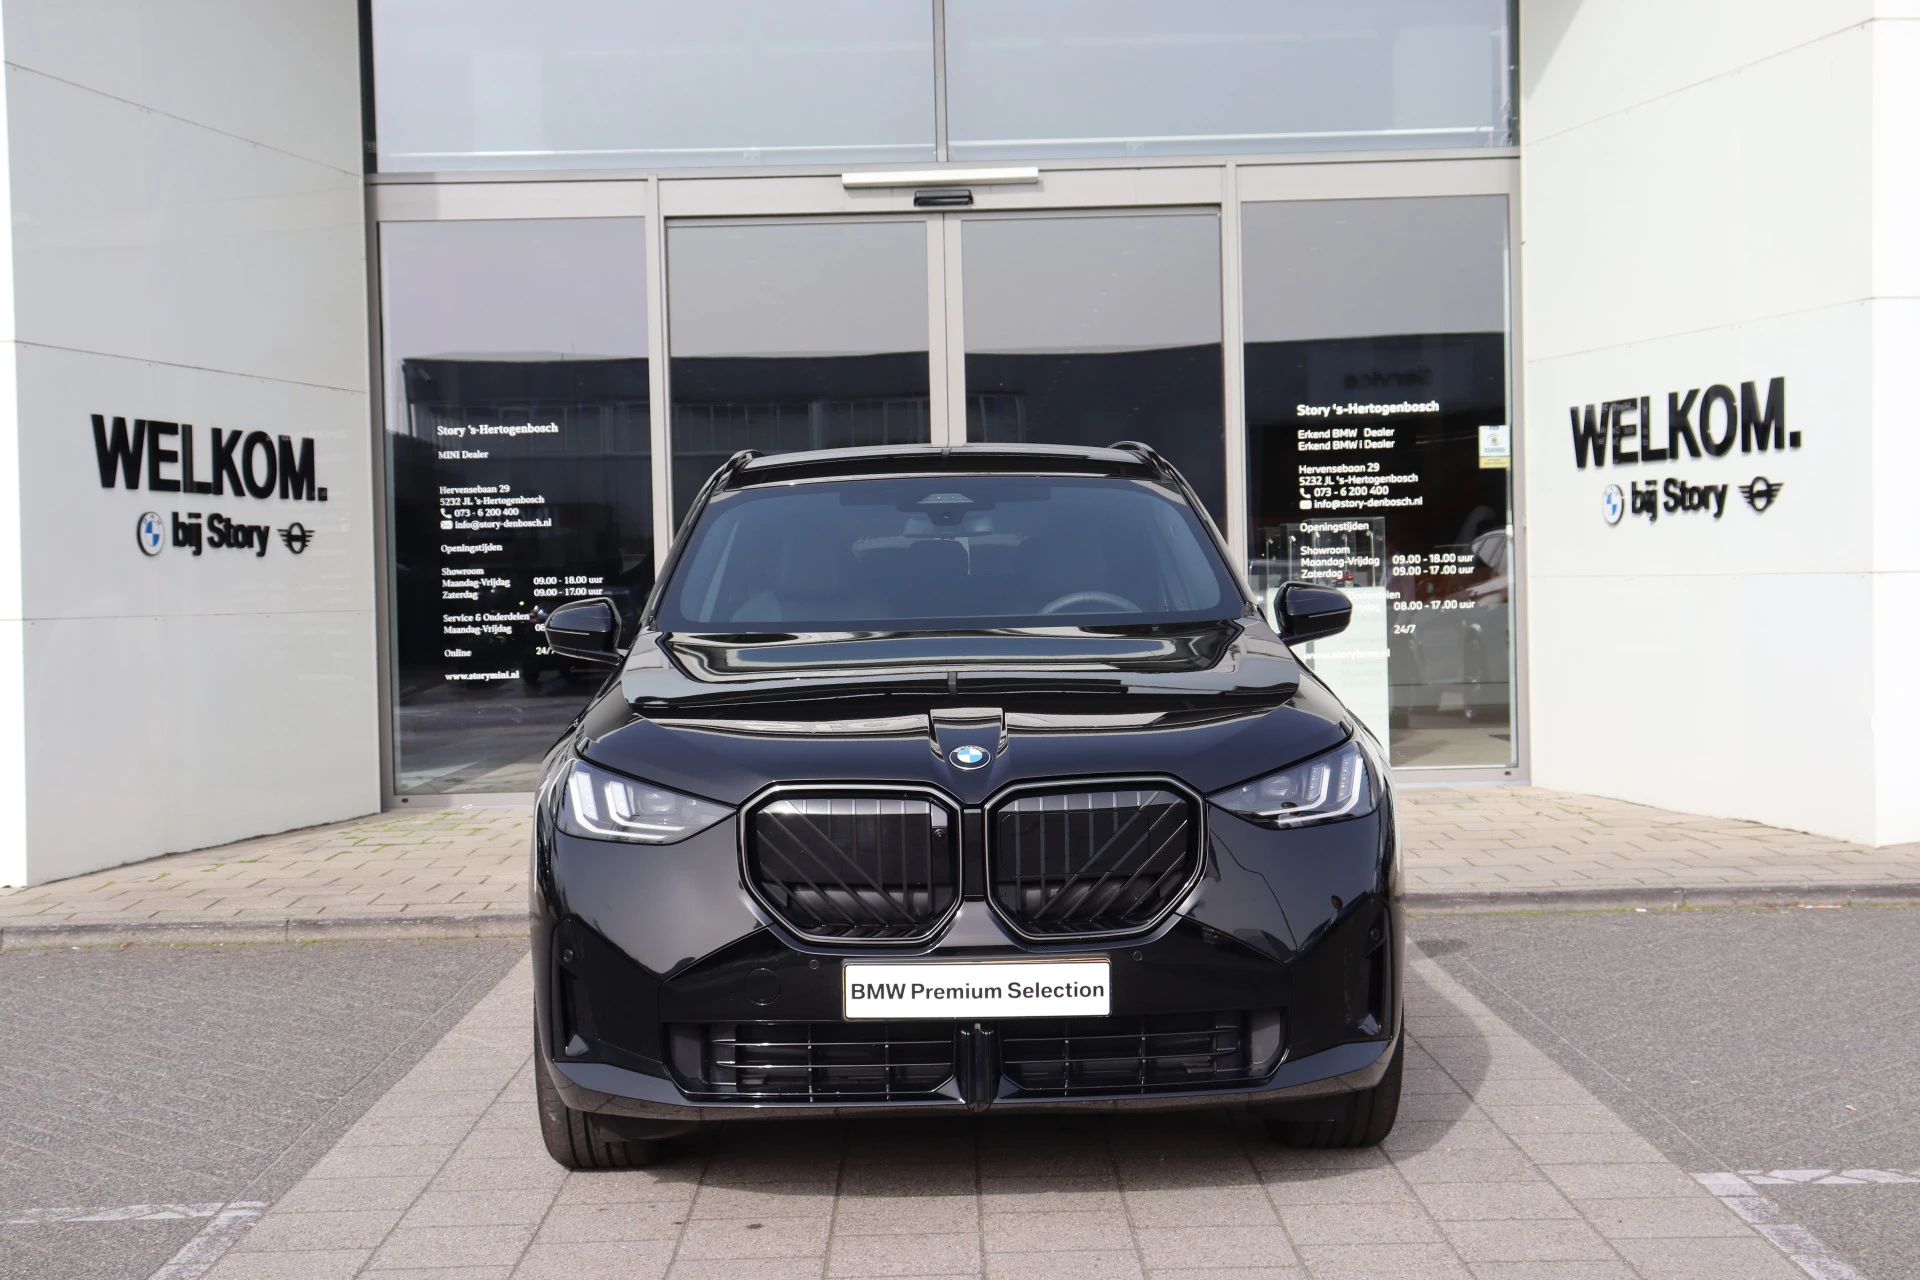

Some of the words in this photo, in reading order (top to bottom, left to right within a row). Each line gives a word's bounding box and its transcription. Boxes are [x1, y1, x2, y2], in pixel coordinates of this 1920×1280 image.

[1297, 404, 1330, 417] Story
[1332, 400, 1439, 415] 's-Hertogenbosch
[1570, 376, 1801, 469] WELKOM.
[437, 426, 466, 437] Story
[468, 423, 558, 436] 's-Hertogenbosch
[1298, 429, 1330, 439] Erkend
[1332, 429, 1357, 438] BMW
[1364, 428, 1395, 437] Dealer
[1298, 441, 1330, 451] Erkend
[1333, 440, 1358, 450] BMW
[1359, 440, 1363, 449] i
[1364, 439, 1395, 449] Dealer
[91, 414, 328, 501] WELKOM.
[438, 451, 460, 459] MINI
[462, 450, 489, 458] Dealer
[1299, 464, 1365, 474] Hervensebaan
[1367, 463, 1380, 472] 29
[1299, 476, 1322, 486] 5232
[1324, 476, 1335, 485] JL
[1336, 473, 1418, 485] 's-Hertogenbosch
[440, 485, 497, 494] Hervensebaan
[499, 485, 510, 493] 29
[1314, 488, 1331, 497] 073
[1340, 487, 1347, 496] 6
[1349, 486, 1367, 496] 200
[1369, 486, 1389, 495] 400
[440, 498, 461, 506] 5232
[462, 497, 473, 505] JL
[474, 495, 545, 506] 's-Hertogenbosch
[1314, 496, 1422, 510] info@story-denbosch.nl
[1632, 480, 1657, 521] bij
[1664, 478, 1727, 518] Story
[454, 509, 470, 517] 073
[485, 508, 501, 516] 200
[455, 518, 551, 530] info@story-denbosch.nl
[1300, 521, 1370, 534] Openingstijden
[172, 512, 202, 556] bij
[208, 513, 269, 557] Story
[441, 543, 503, 554] Openingstijden
[1299, 545, 1351, 556] Showroom
[1300, 556, 1380, 568] Maandag-Vrijdag
[1392, 555, 1421, 564] 09.00
[1429, 553, 1456, 563] 18.00
[1301, 570, 1344, 580] Zaterdag
[1392, 566, 1421, 576] 09.00
[1429, 565, 1456, 574] 17.00
[442, 578, 511, 588] Maandag-Vrijdag
[533, 577, 557, 585] 09.00
[565, 576, 587, 584] 18.00
[443, 590, 478, 600] Zaterdag
[534, 588, 558, 596] 09.00
[565, 588, 587, 596] 17.00
[1393, 600, 1423, 611] 08.00
[1431, 600, 1458, 610] 17.00
[1458, 600, 1476, 609] uur
[443, 614, 474, 622] Service
[483, 612, 530, 621] Onderdelen
[444, 625, 512, 635] Maandag-Vrijdag
[1393, 625, 1416, 635] 24/7
[444, 649, 471, 657] Online
[445, 670, 519, 681] www.storymini.nl
[852, 984, 905, 999] BMW
[912, 983, 1001, 999] Premium
[1008, 982, 1103, 998] Selection
